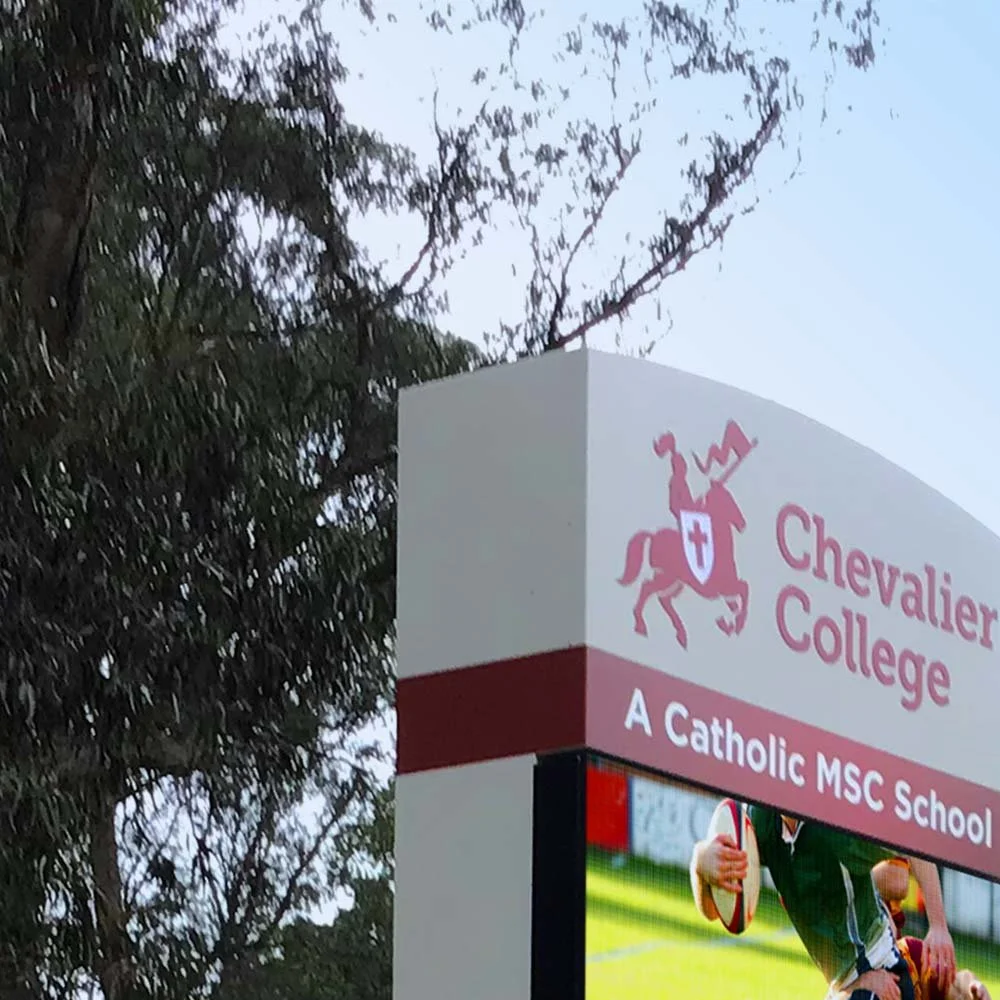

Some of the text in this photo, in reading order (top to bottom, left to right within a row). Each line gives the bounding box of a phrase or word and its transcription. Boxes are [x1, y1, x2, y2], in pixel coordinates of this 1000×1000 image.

[776, 502, 999, 650] Chevalier
[776, 584, 951, 711] College
[624, 687, 993, 849] A Catholic MSC School
